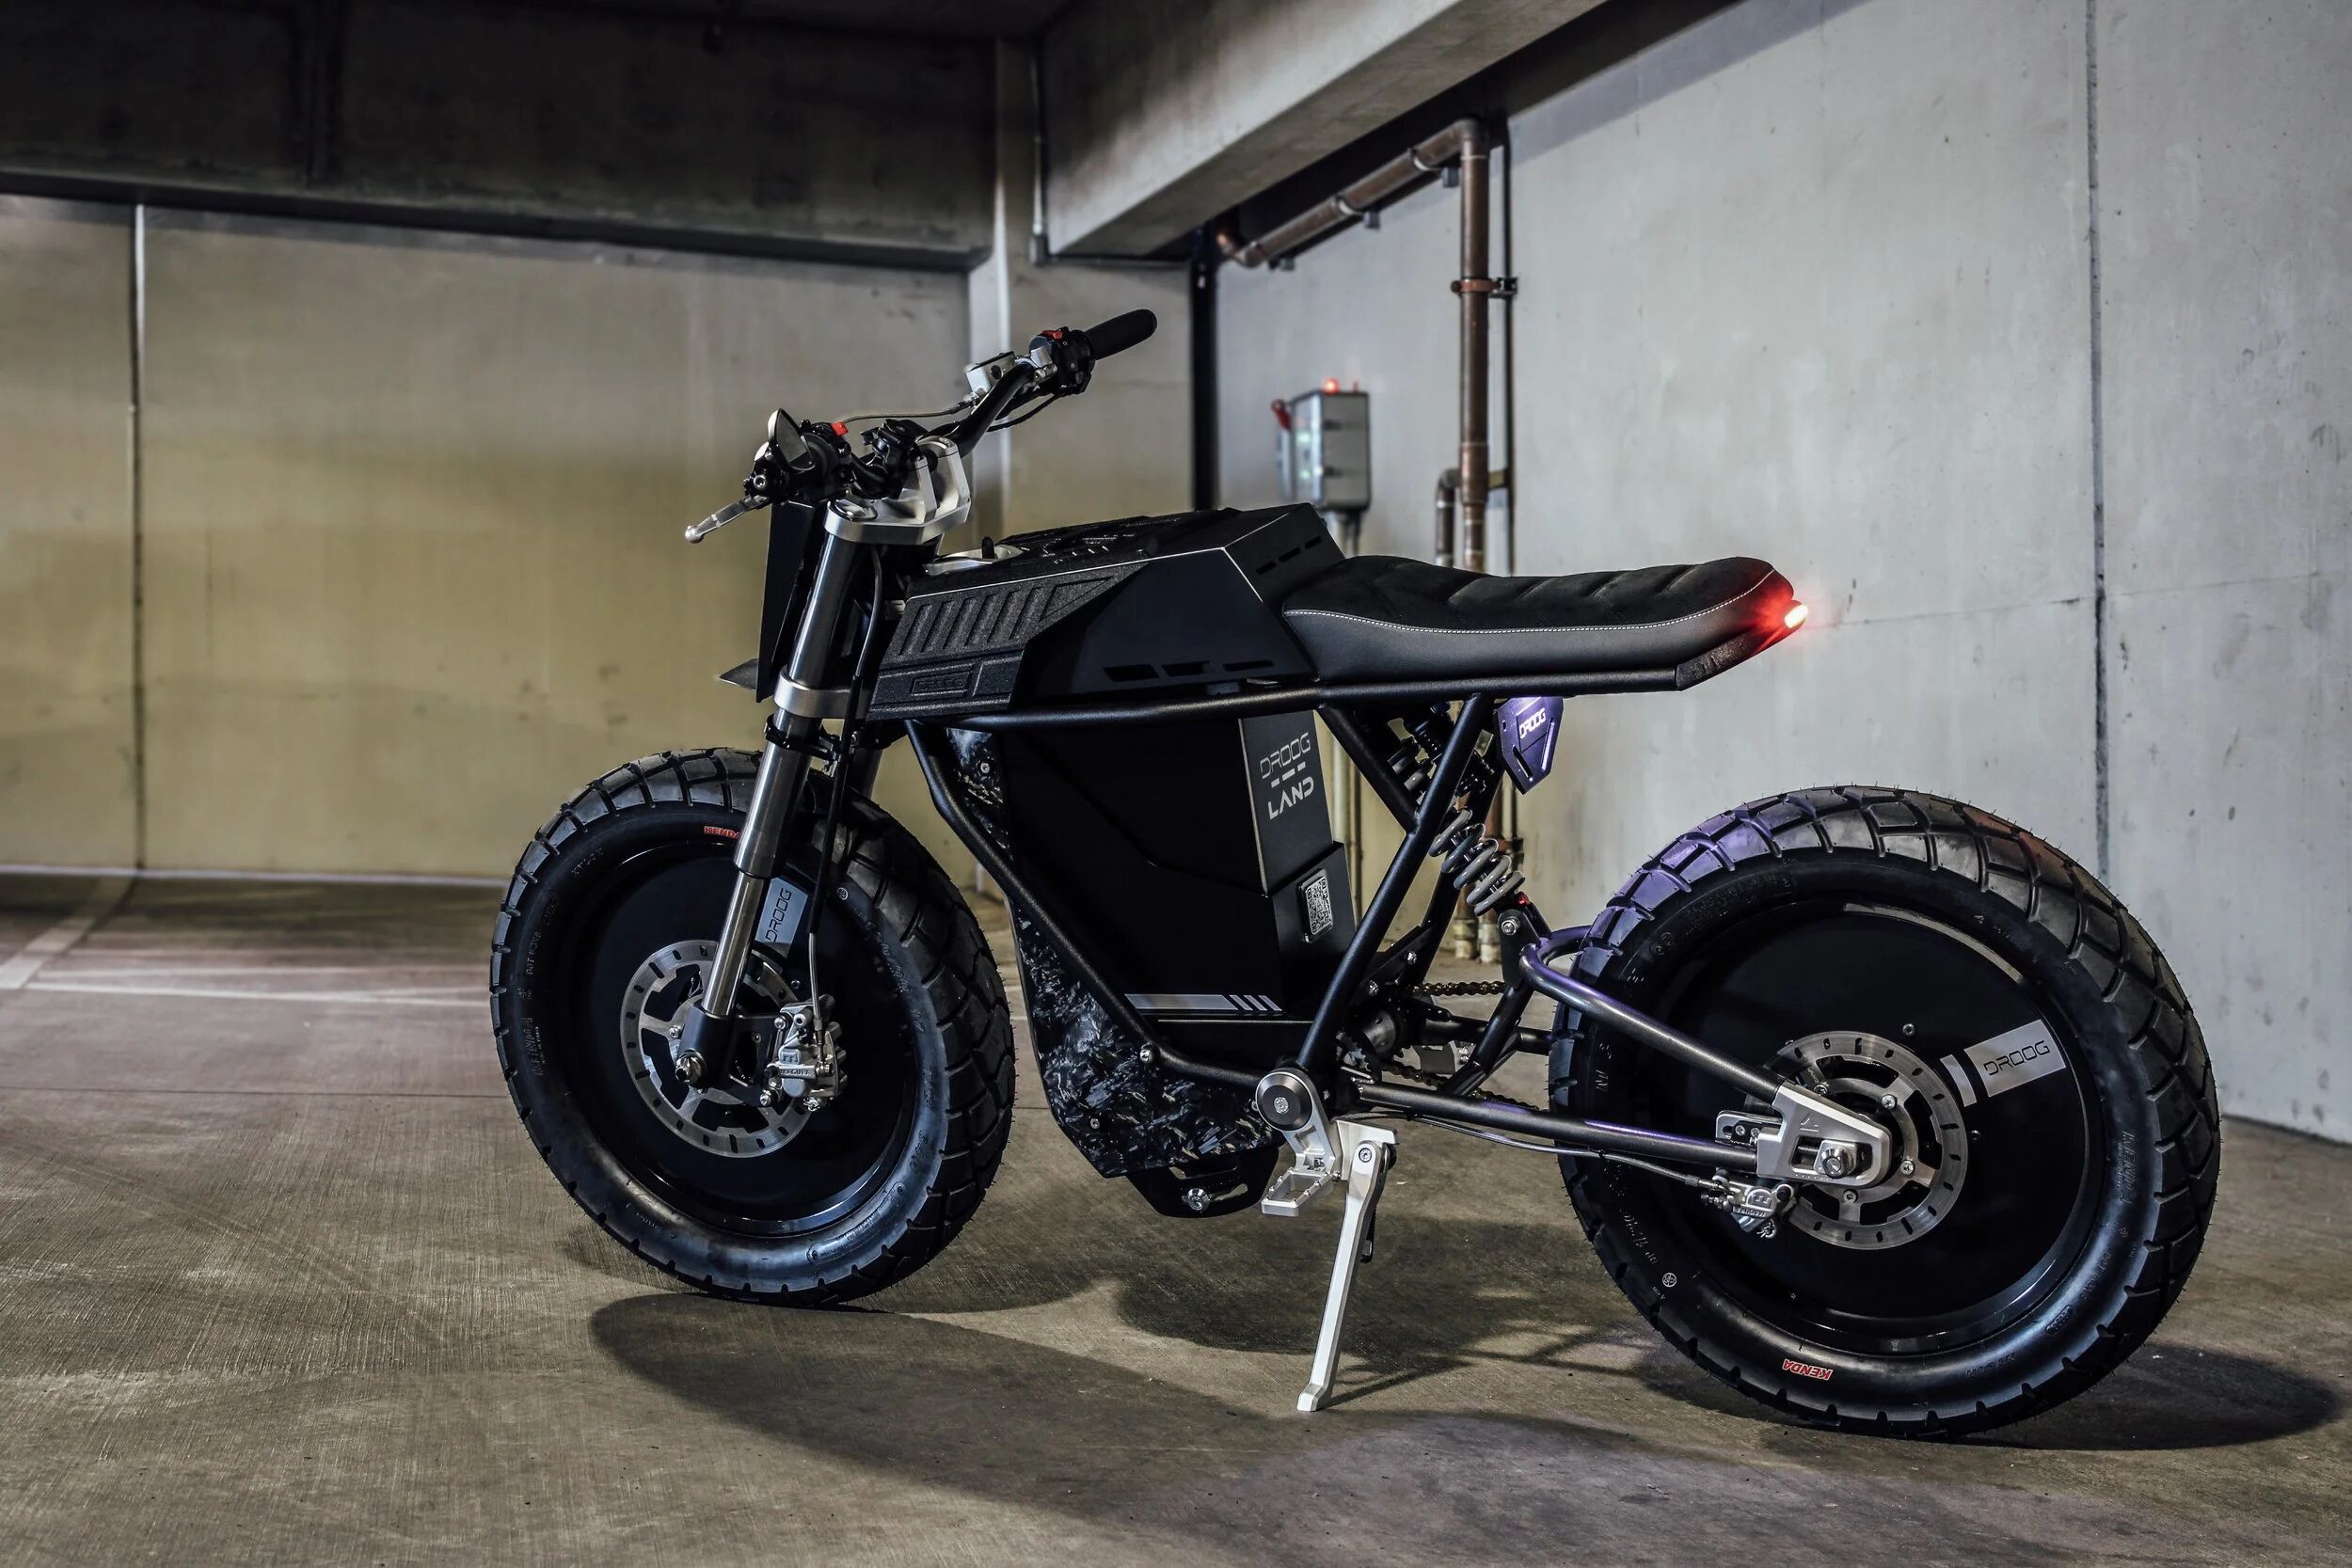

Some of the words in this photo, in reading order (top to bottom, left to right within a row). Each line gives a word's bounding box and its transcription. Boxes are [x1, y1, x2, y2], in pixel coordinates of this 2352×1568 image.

[1519, 707, 1546, 738] DROOG
[1260, 732, 1311, 779] DROOG
[1267, 776, 1314, 820] LAND
[765, 887, 792, 942] DROOG
[1983, 1040, 2051, 1076] DROOG
[1782, 1358, 1834, 1381] KENDA
